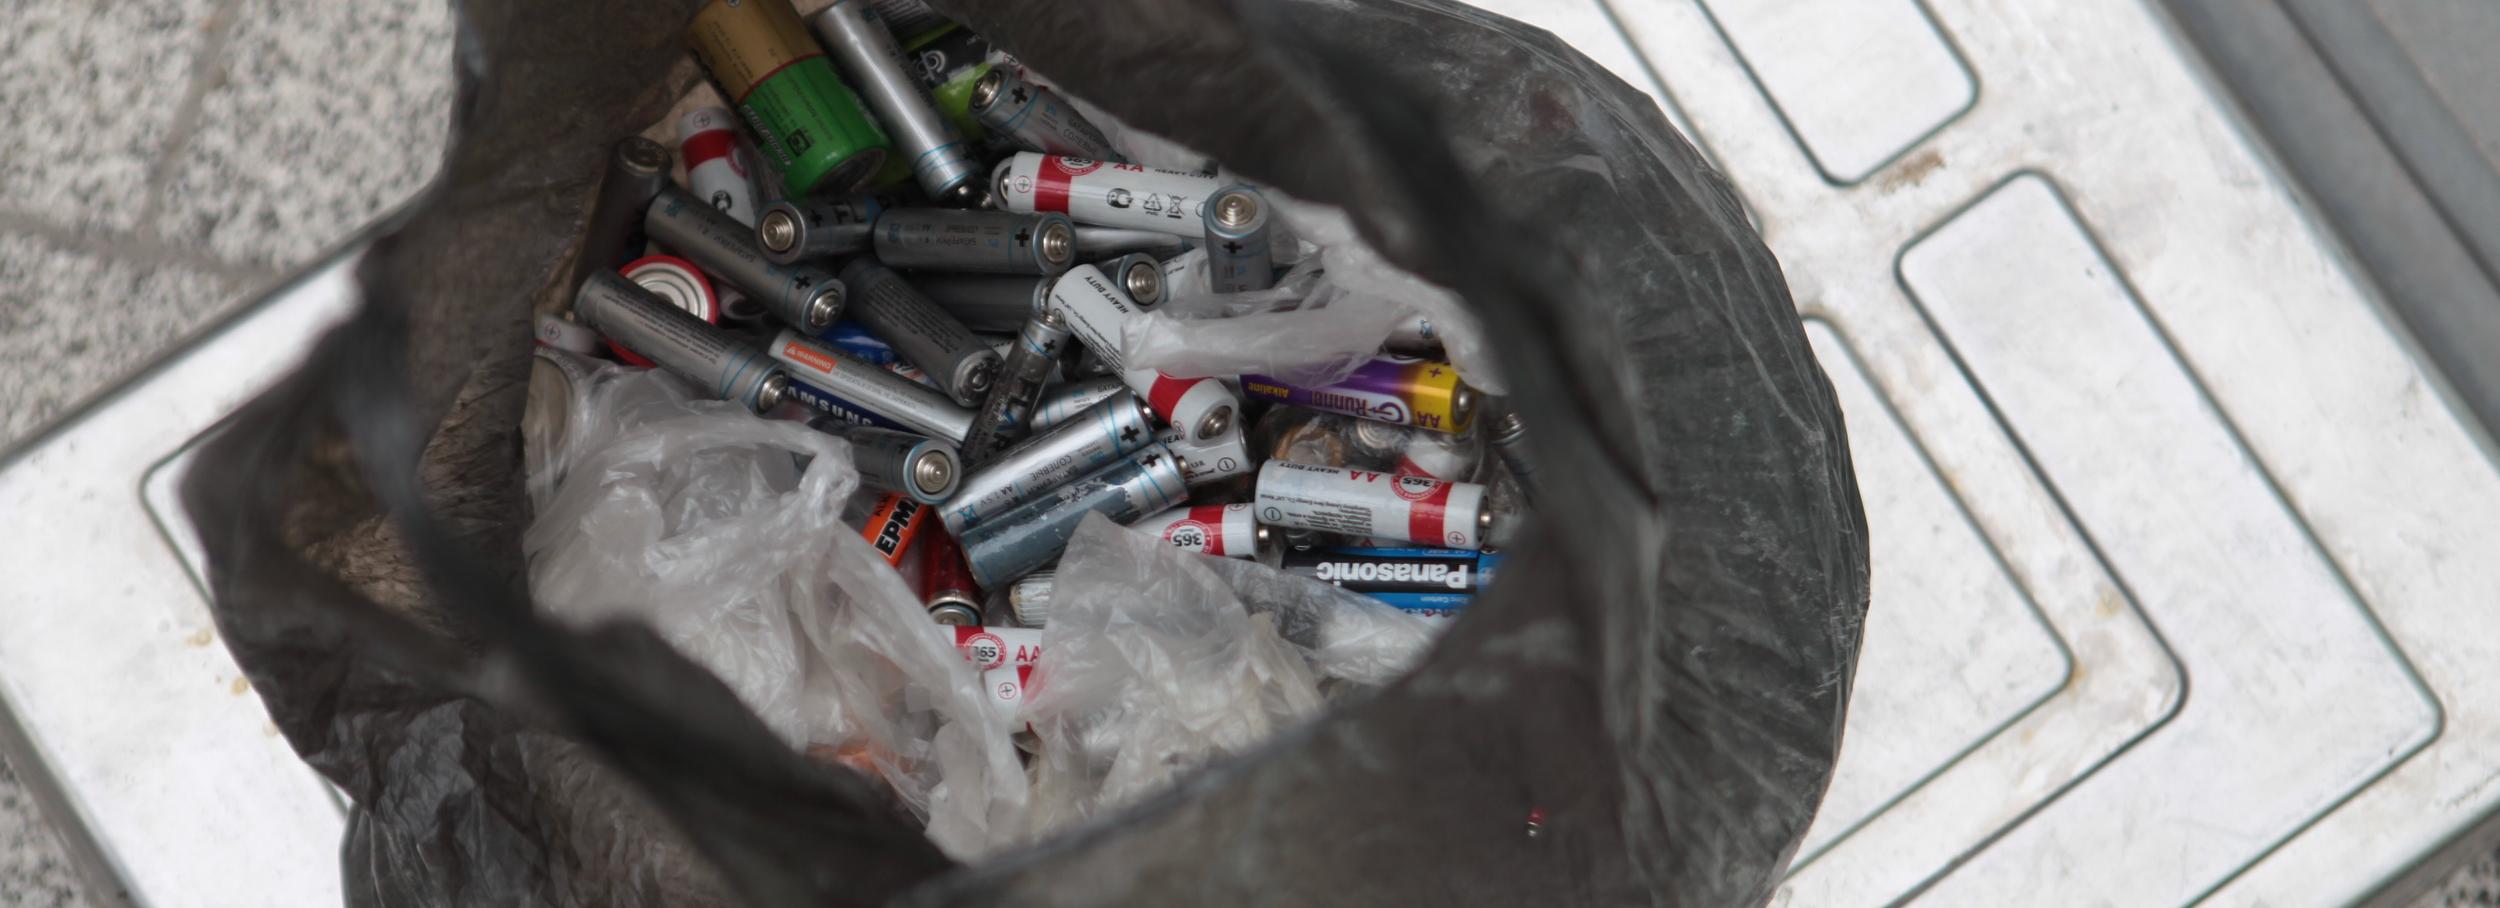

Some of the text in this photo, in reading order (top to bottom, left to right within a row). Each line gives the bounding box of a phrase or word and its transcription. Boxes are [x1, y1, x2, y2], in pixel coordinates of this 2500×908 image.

[1084, 273, 1129, 316] HEAVY DUTY
[1247, 382, 1289, 399] Alkaline
[785, 384, 872, 426] AMSUN
[1416, 412, 1441, 428] AA
[1029, 453, 1073, 483] СОЛЕВЫЕ
[1279, 461, 1380, 483] AA HEAVY DUTY
[1402, 477, 1432, 487] 365
[1171, 535, 1203, 547] 365
[1316, 561, 1468, 589] Panasonic
[1016, 645, 1041, 662] AA
